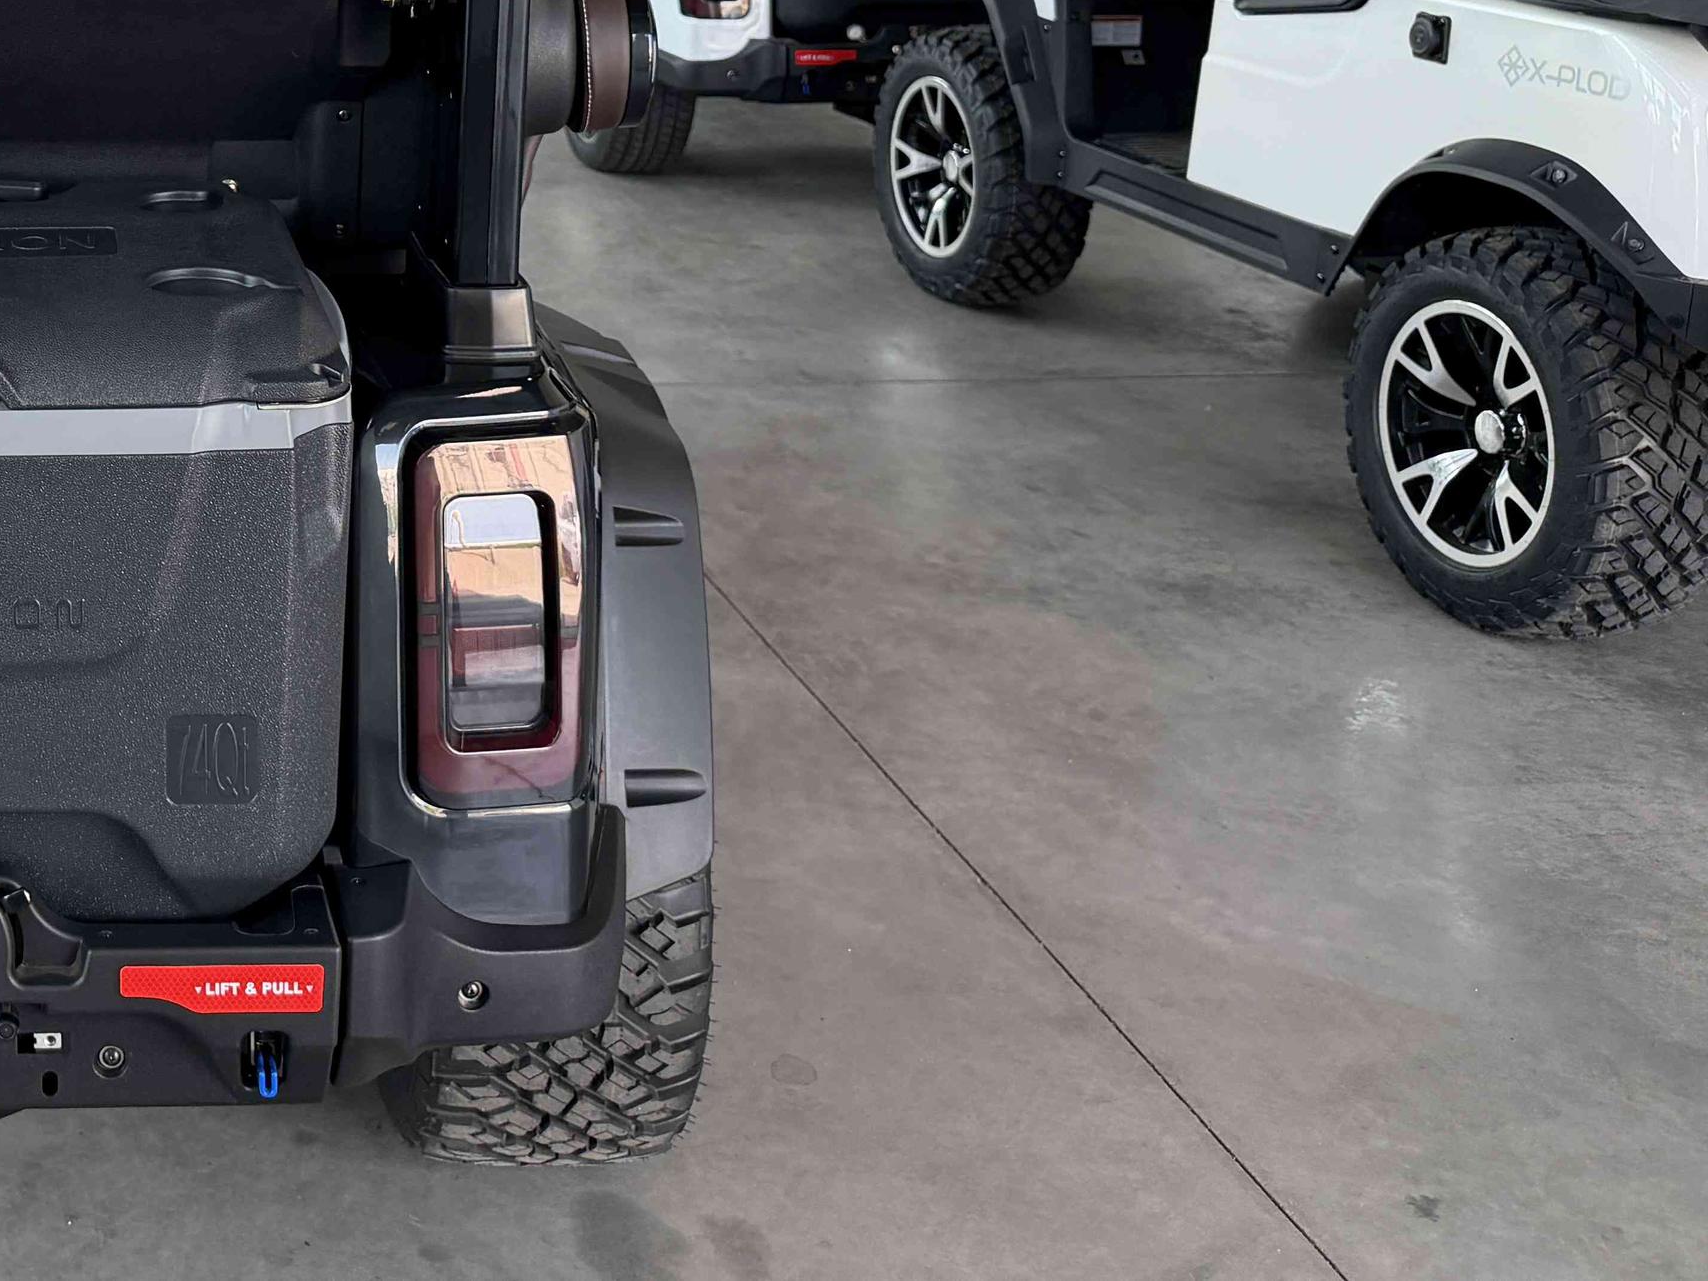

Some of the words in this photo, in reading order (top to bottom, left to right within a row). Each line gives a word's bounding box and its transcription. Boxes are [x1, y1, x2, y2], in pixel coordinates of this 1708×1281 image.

[1528, 57, 1632, 101] X-PLOD
[205, 982, 241, 996] LIFT
[245, 982, 257, 996] &
[262, 981, 304, 995] PULL
